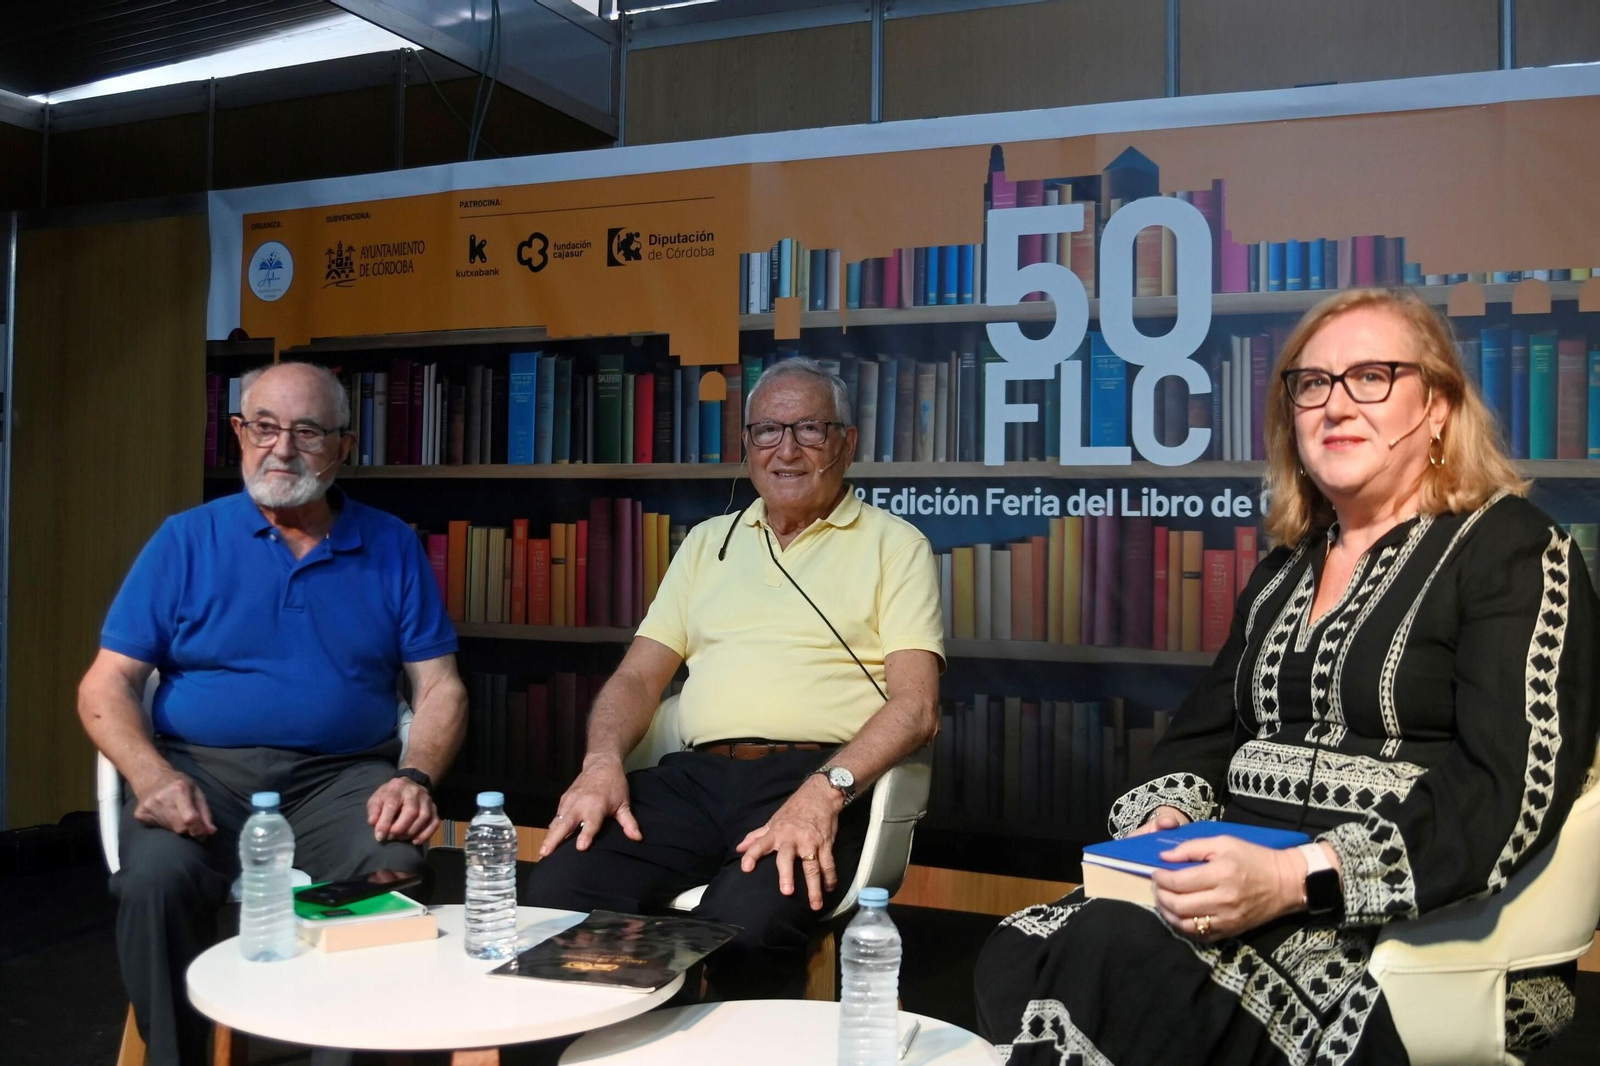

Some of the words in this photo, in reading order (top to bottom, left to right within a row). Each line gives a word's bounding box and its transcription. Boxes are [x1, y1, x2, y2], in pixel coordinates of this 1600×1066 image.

[459, 199, 503, 209] PATROCINA:
[251, 221, 283, 230] ORGANIZA:
[325, 212, 372, 223] SUBVENCIONA:
[553, 240, 592, 251] fundación
[648, 230, 715, 246] Diputación
[359, 240, 426, 260] AYUNTAMIENTO
[552, 250, 584, 259] cajasur
[648, 249, 663, 261] de
[666, 245, 715, 260] Córdoba
[359, 263, 371, 278] DE
[371, 259, 415, 277] CÓRDOBA
[455, 268, 500, 278] kutxabank
[986, 196, 1213, 366] 50
[984, 357, 1212, 466] FLC
[872, 487, 979, 516] Edición
[986, 487, 1060, 516] Feria
[1067, 488, 1114, 517] del
[1121, 487, 1204, 517] Libro
[1211, 488, 1253, 517] de
